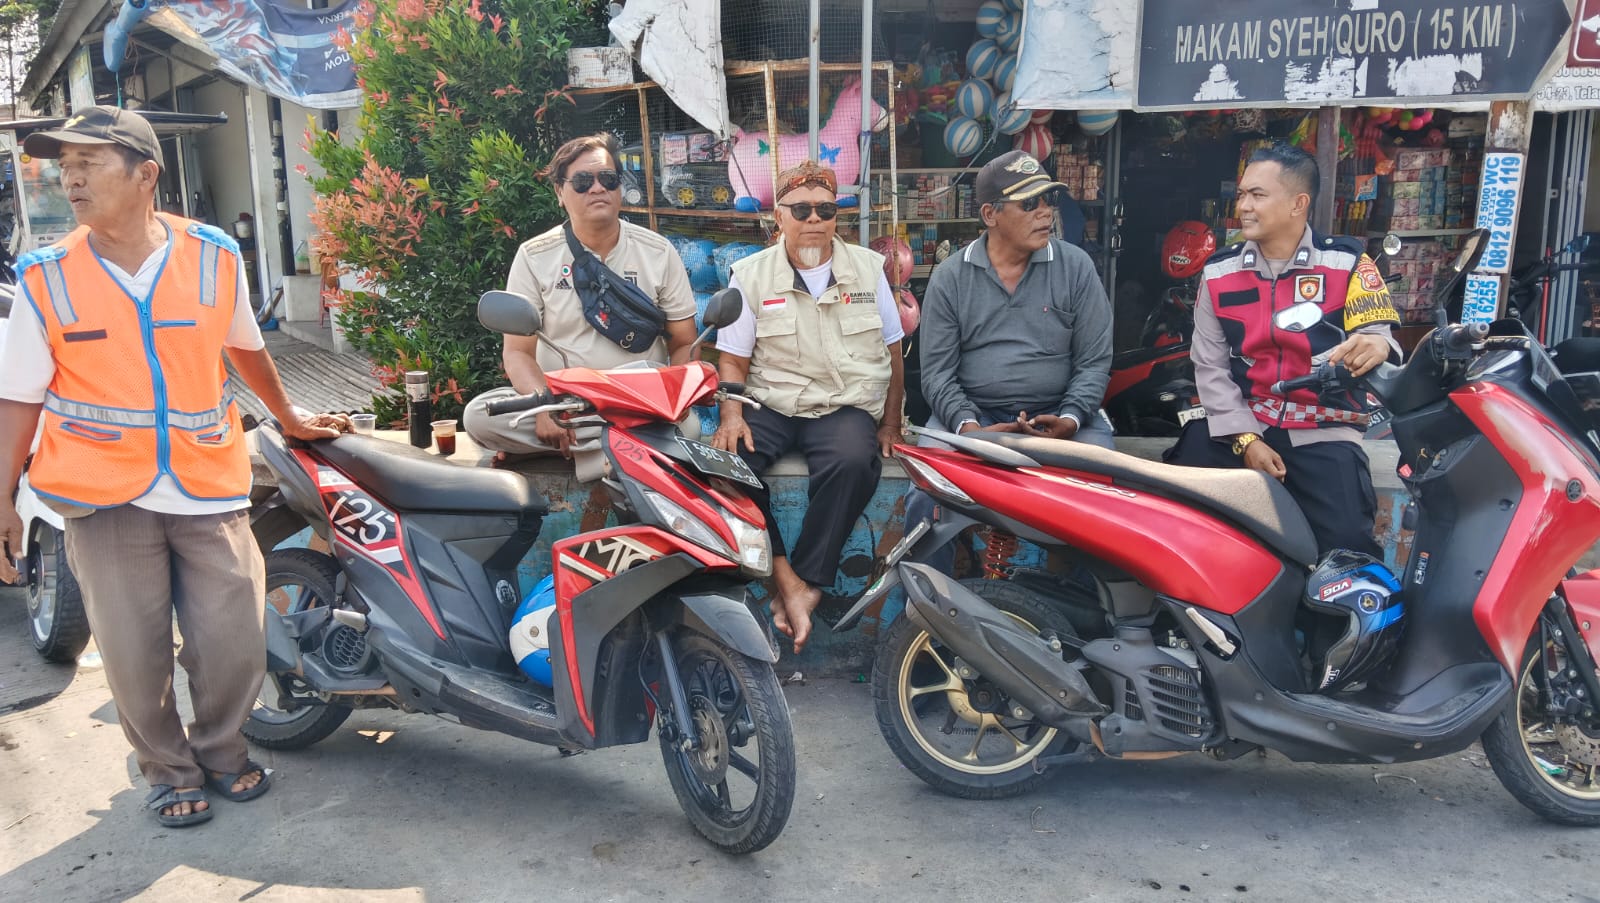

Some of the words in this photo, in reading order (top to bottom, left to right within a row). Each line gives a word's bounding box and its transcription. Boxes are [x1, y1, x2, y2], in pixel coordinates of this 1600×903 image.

[1175, 20, 1262, 64] MAKAM
[1267, 15, 1330, 59] SYEH
[1335, 11, 1406, 57] QURO
[1429, 8, 1455, 50] 15
[1461, 5, 1503, 49] KM
[324, 51, 351, 72] now
[1483, 157, 1500, 186] WC
[1498, 156, 1521, 185] 119
[1480, 187, 1491, 212] 5000
[1493, 189, 1516, 227] 9096
[1487, 230, 1511, 269] 0812
[1464, 280, 1480, 305] WC
[1477, 280, 1498, 313] 6255
